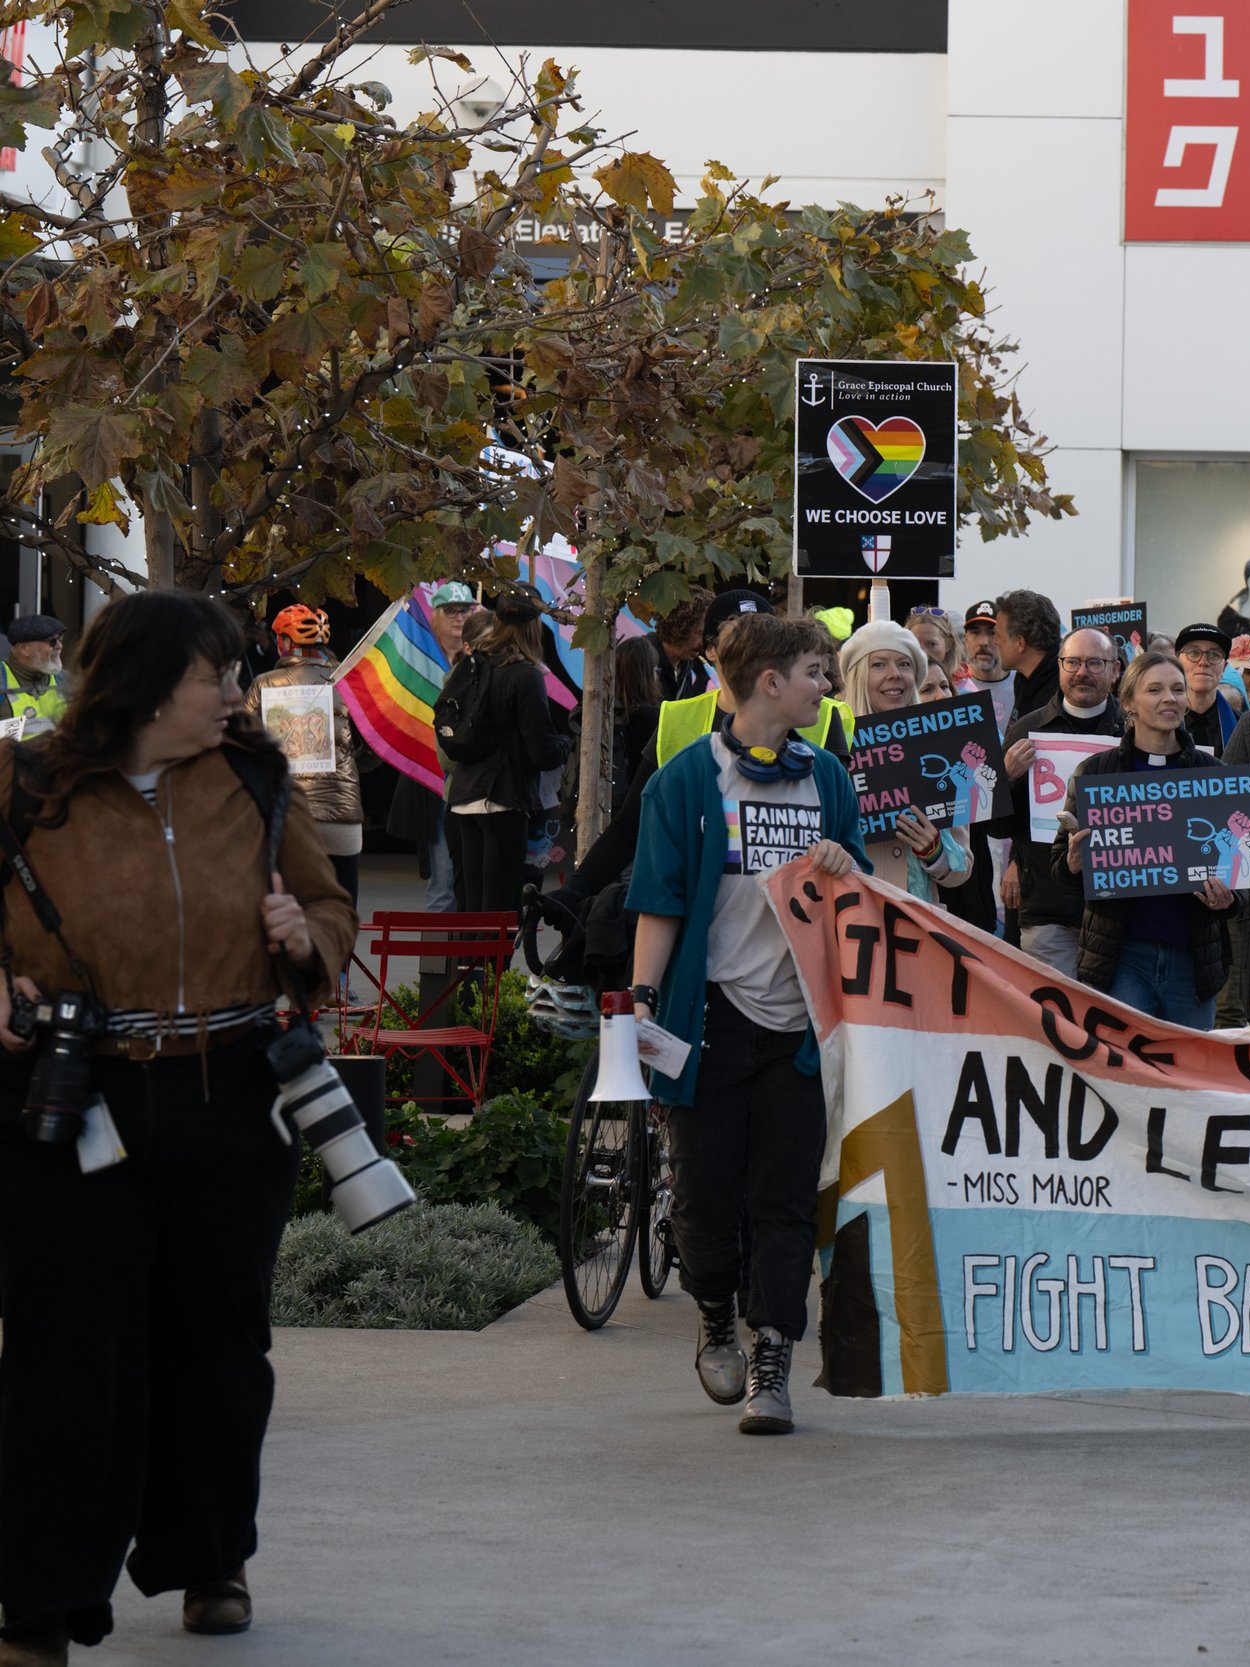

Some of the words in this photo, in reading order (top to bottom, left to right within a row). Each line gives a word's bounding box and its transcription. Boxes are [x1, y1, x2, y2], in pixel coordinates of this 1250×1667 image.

[838, 380, 866, 391] Grace
[868, 381, 914, 392] Episcopal
[917, 382, 952, 392] Church
[838, 392, 862, 401] Love
[866, 392, 875, 401] in
[879, 392, 911, 401] action
[806, 509, 830, 524] WE
[835, 509, 901, 524] CHOOSE
[905, 510, 947, 525] LOVE
[1074, 609, 1142, 626] TRANSGENDER
[848, 743, 905, 772] GHTS
[859, 787, 910, 814] MAN
[745, 806, 820, 828] RAINBOW
[1087, 803, 1173, 826] RIGHTS
[746, 826, 821, 847] FAMILIES
[1089, 827, 1134, 847] ARE
[751, 849, 803, 868] ACTI
[1091, 846, 1174, 868] HUMAN
[1093, 866, 1178, 890] RIGHTS
[940, 1050, 1119, 1161] AND
[1033, 1173, 1113, 1207] MAJOR
[962, 1252, 1155, 1354] FIGHT
